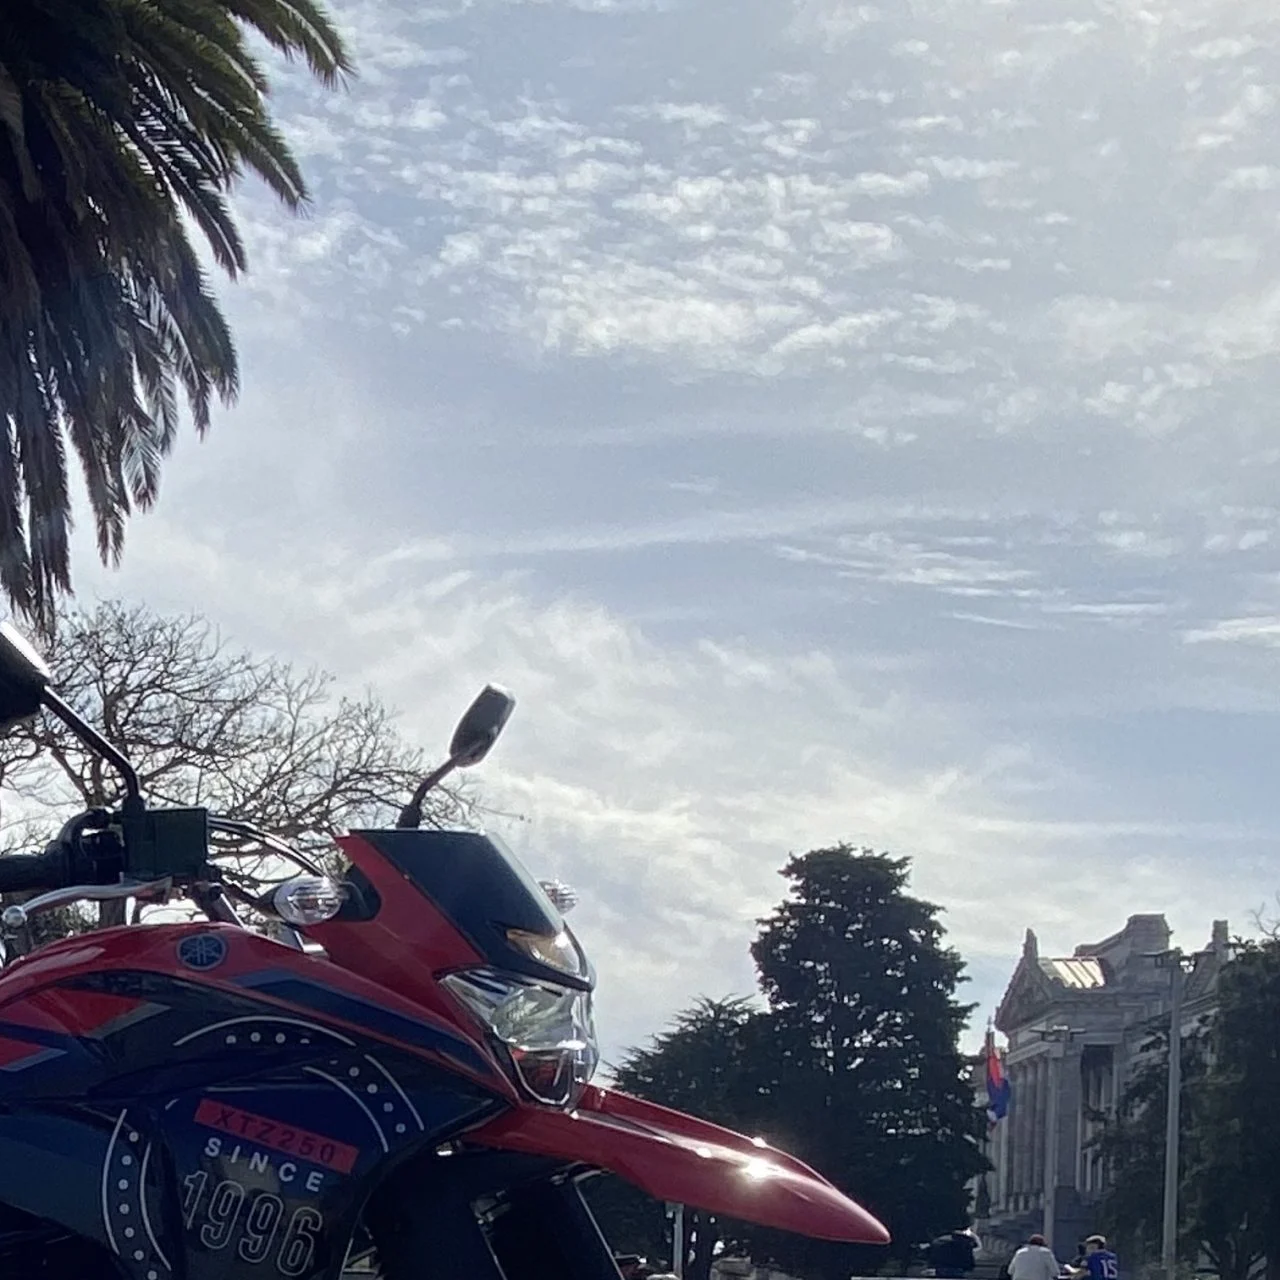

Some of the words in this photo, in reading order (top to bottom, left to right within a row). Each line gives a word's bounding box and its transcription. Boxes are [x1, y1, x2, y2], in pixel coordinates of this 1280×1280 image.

[214, 1108, 336, 1164] XTZ250
[204, 1136, 324, 1193] SINCE
[183, 1169, 324, 1277] 1996
[1100, 1259, 1118, 1279] 15
